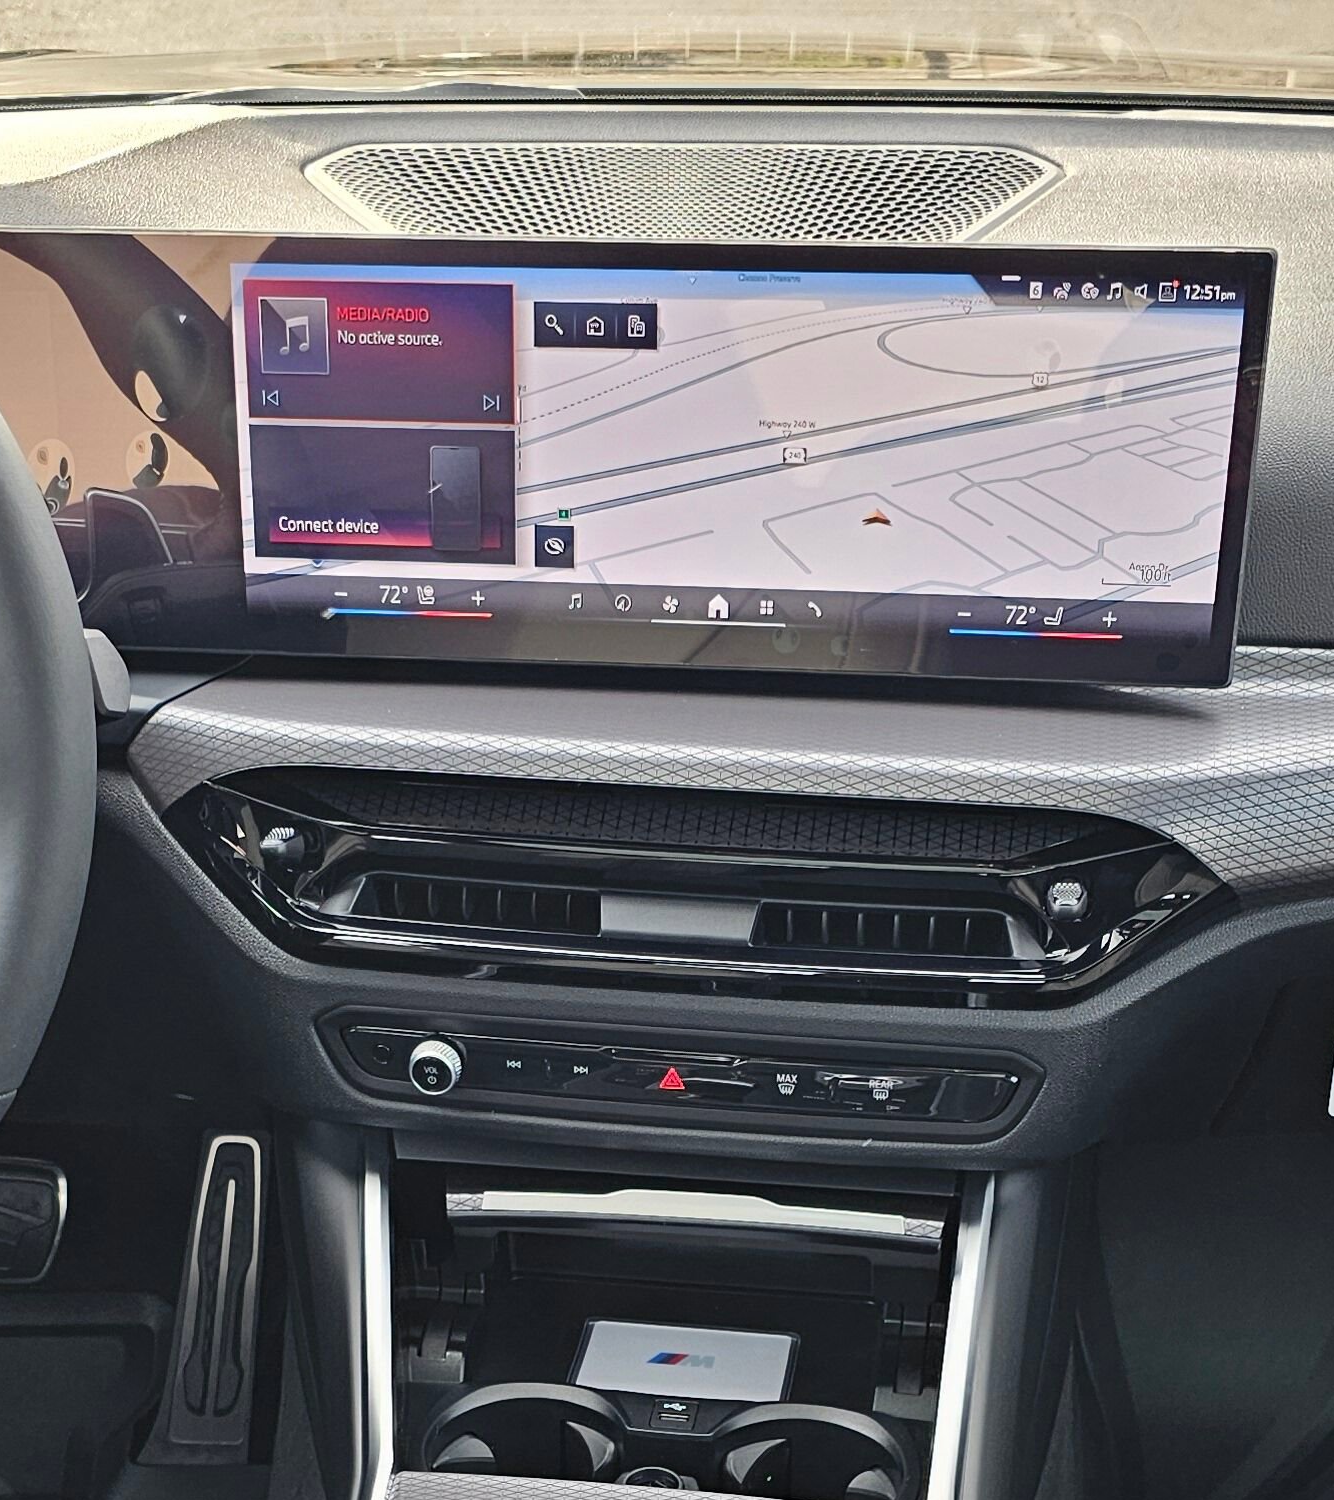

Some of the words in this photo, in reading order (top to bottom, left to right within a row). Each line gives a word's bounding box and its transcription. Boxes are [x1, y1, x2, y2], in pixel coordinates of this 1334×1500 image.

[336, 307, 430, 323] MEDIA/RADIO
[337, 330, 356, 345] No
[359, 331, 395, 346] active
[398, 333, 443, 347] source.
[758, 420, 792, 430] Highway
[793, 420, 807, 429] 240
[278, 516, 334, 533] Connect
[336, 518, 379, 535] device
[776, 1074, 798, 1084] MAX
[868, 1080, 894, 1090] REAR
